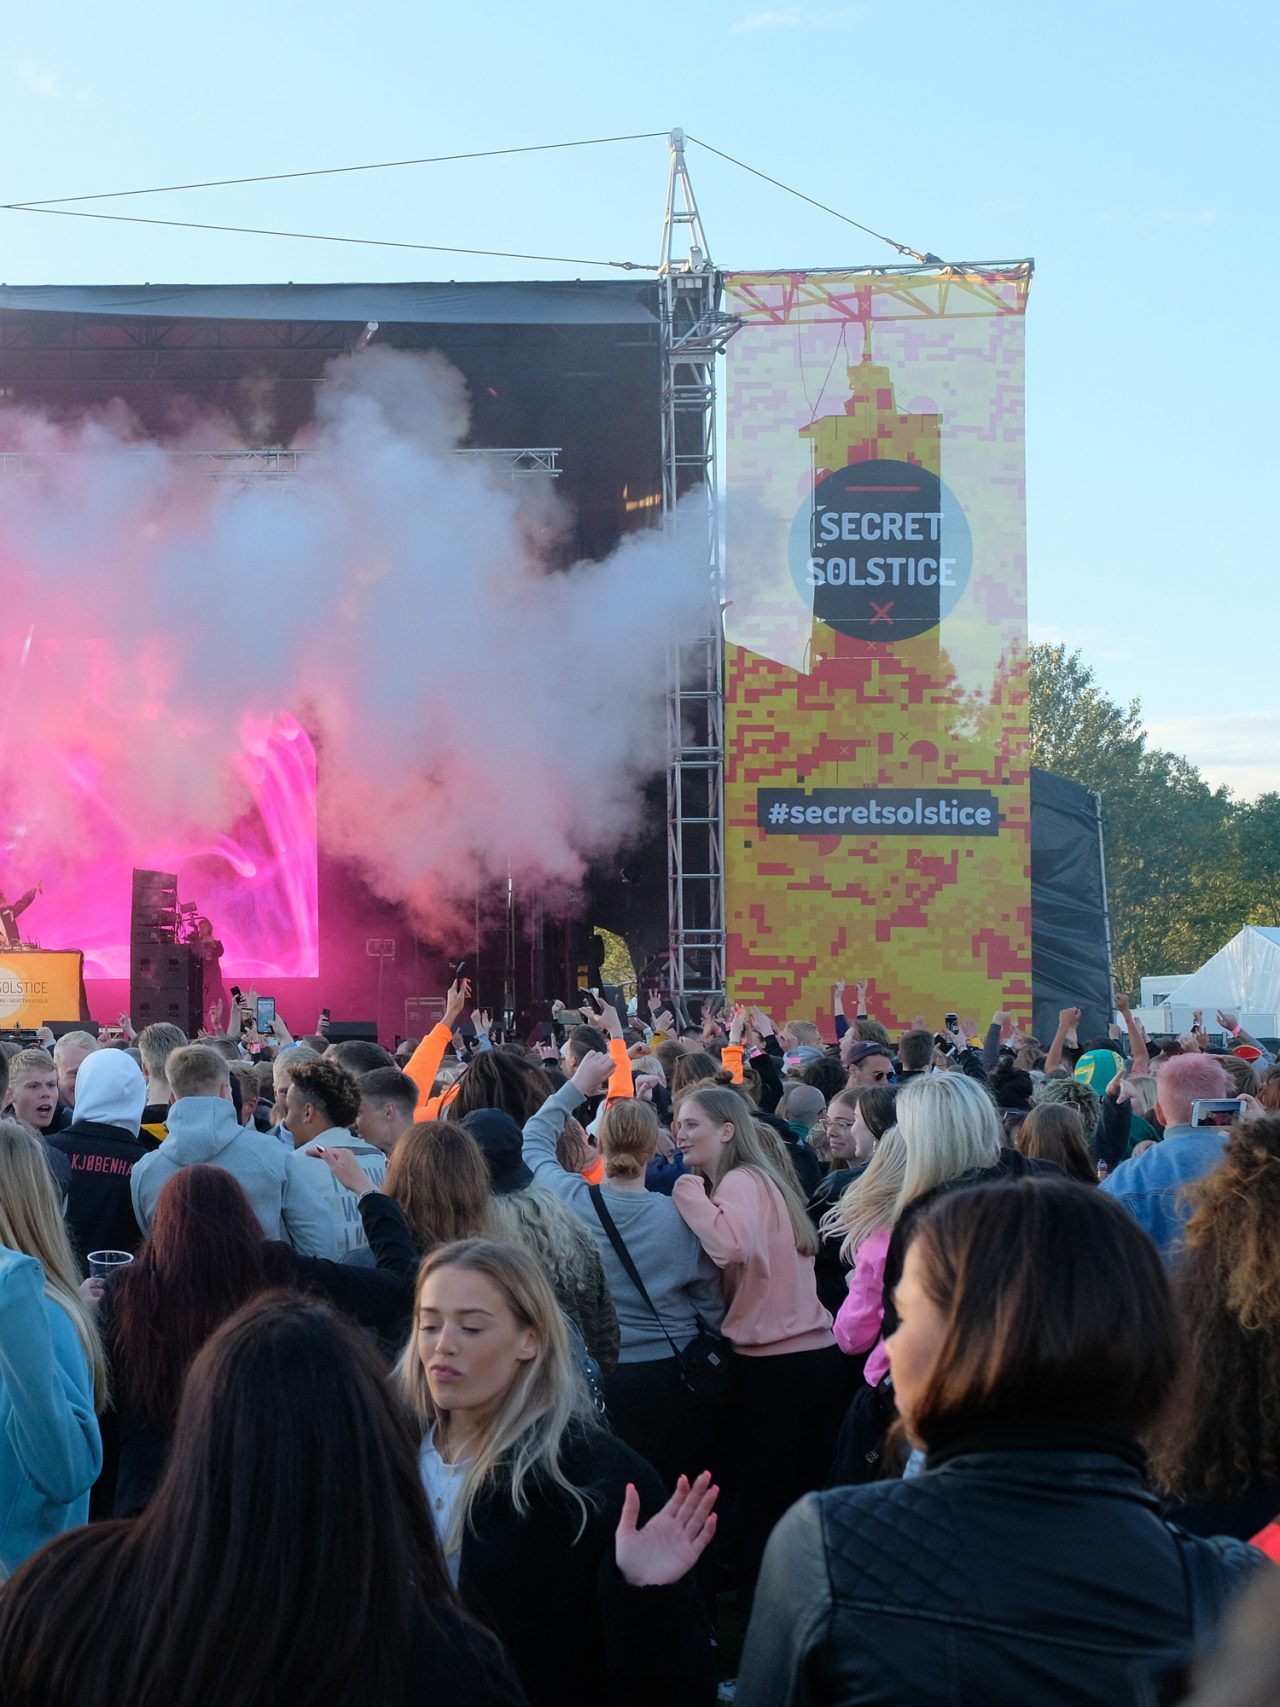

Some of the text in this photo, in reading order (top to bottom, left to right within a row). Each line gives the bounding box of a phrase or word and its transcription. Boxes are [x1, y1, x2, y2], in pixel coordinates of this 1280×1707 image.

[820, 512, 945, 541] SECRET
[805, 557, 957, 586] SOLSTICE
[768, 797, 992, 825] #secretsolstice
